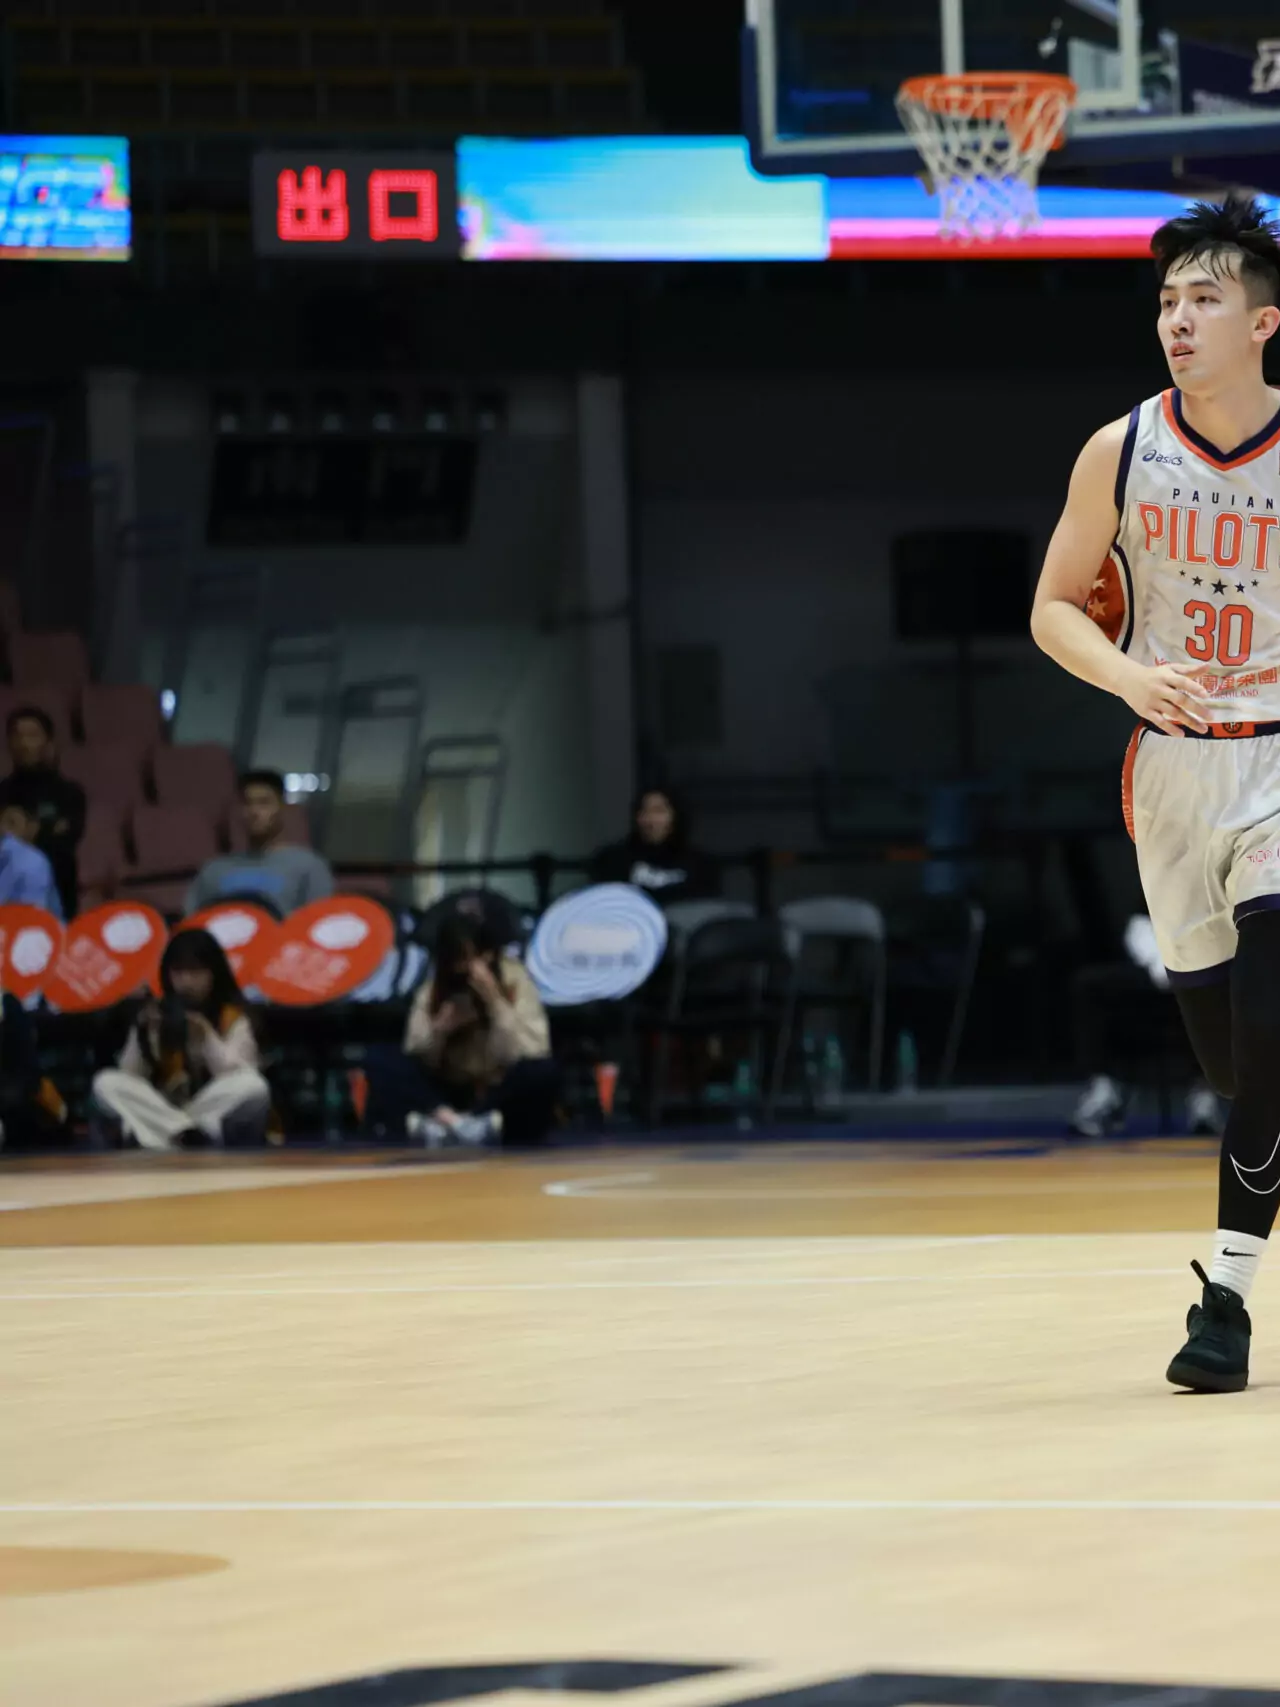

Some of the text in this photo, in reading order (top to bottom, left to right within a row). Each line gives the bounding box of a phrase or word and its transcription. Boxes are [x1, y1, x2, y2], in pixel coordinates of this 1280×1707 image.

[277, 165, 438, 242] 出口
[1156, 452, 1183, 466] asics
[1173, 488, 1274, 509] PAUIAN
[1184, 599, 1254, 667] 30
